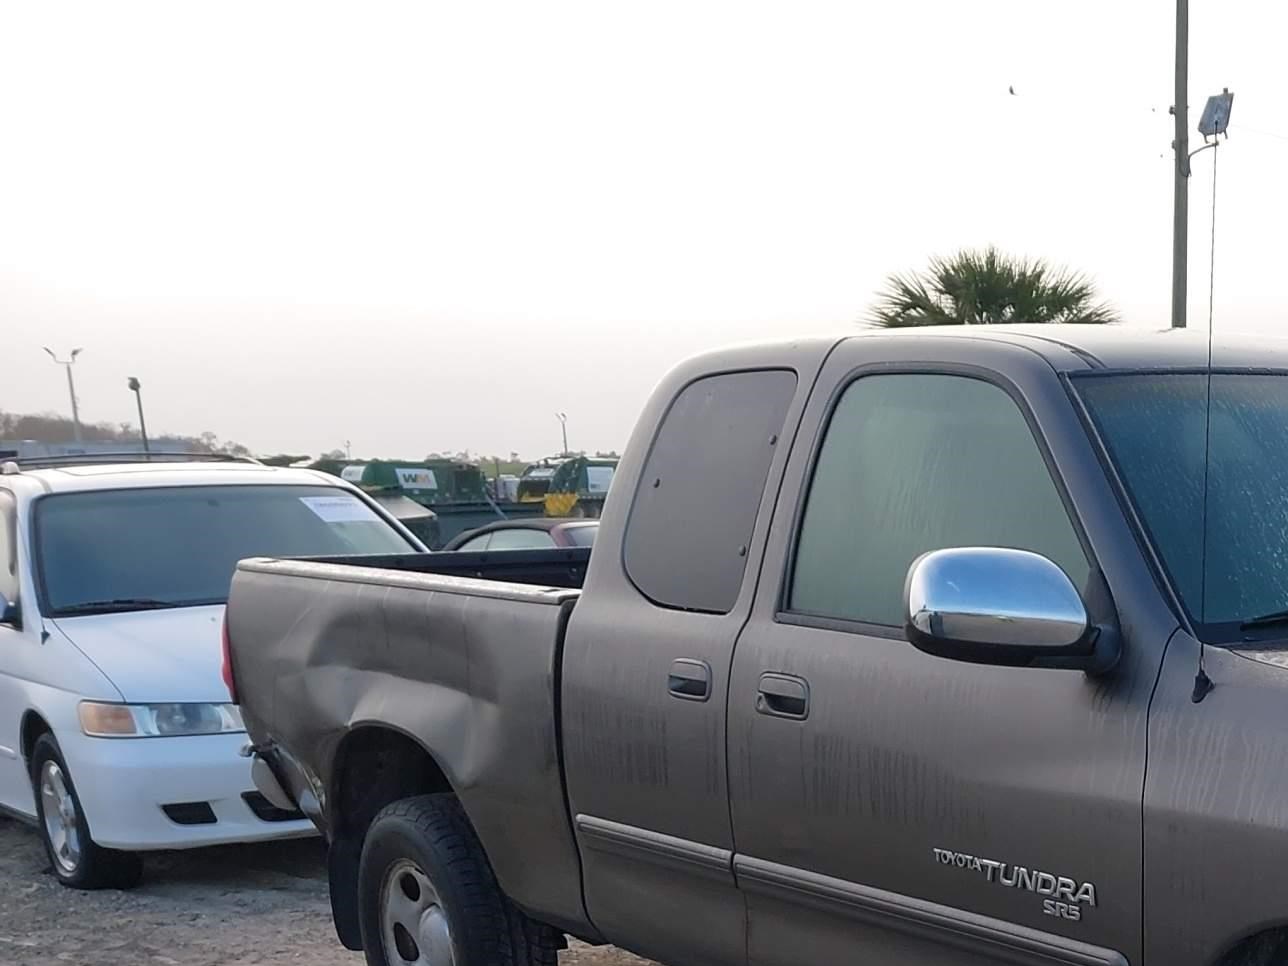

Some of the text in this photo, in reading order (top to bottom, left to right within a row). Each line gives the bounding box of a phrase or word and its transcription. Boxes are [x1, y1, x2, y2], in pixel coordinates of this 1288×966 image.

[933, 848, 1096, 906] TOYOTA TUNDRA
[1043, 899, 1081, 921] SR5
